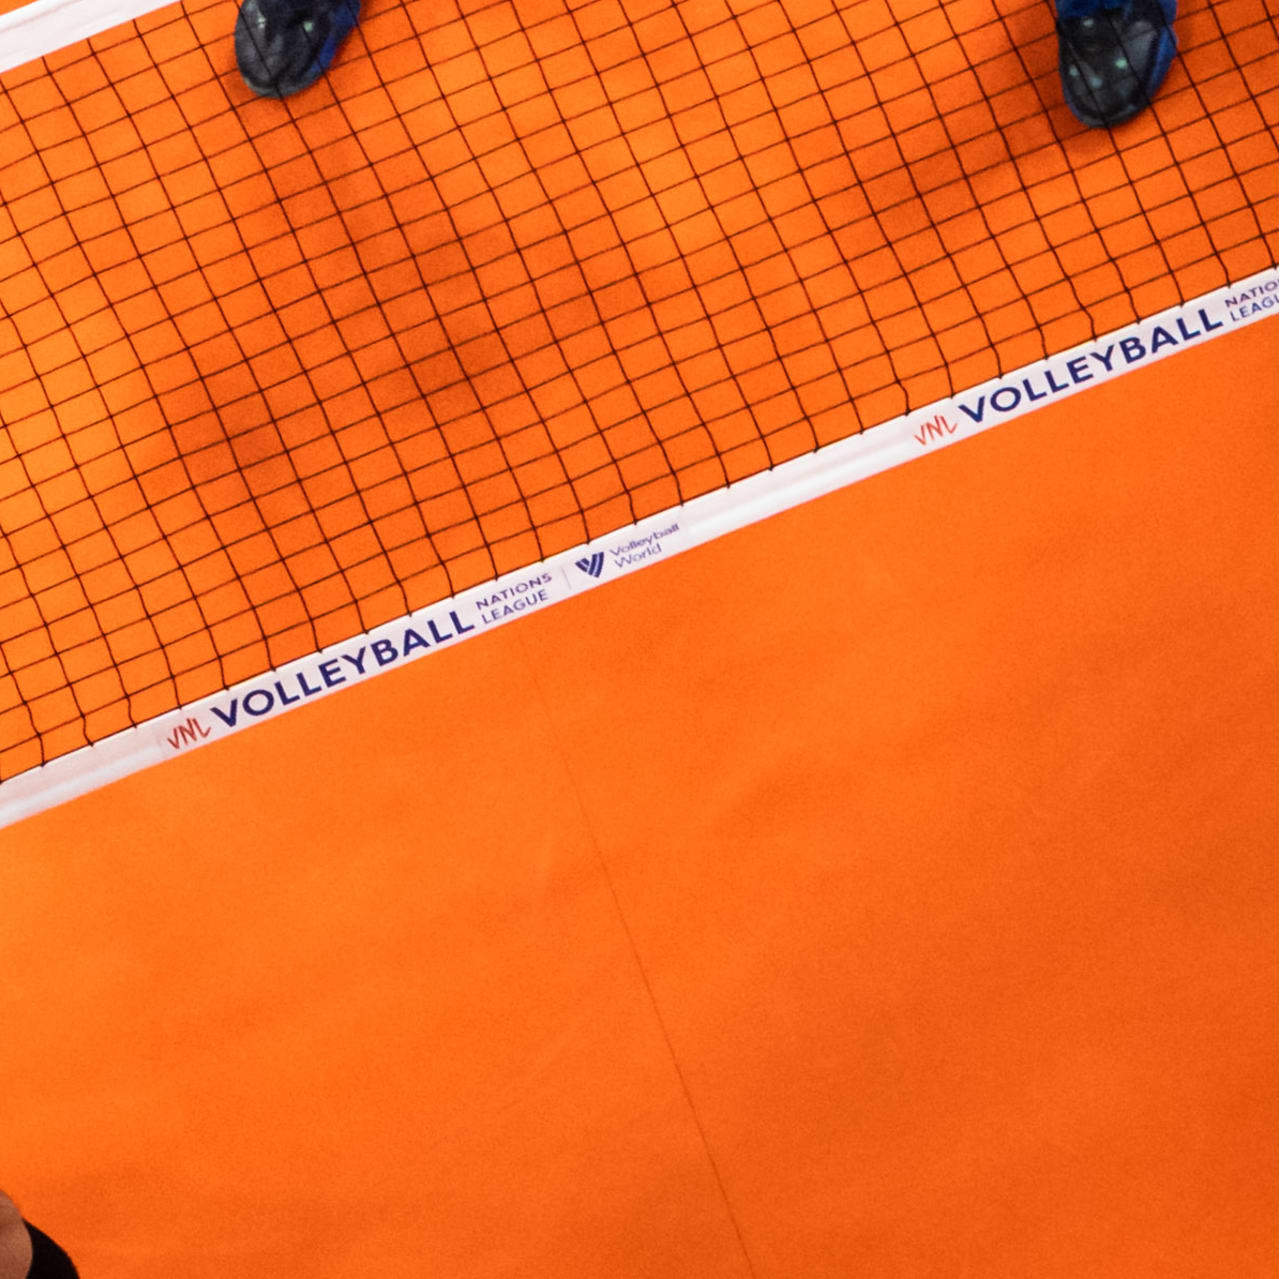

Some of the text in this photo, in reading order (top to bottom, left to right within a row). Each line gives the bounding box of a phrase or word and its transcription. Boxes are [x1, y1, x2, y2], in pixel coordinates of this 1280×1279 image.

[913, 278, 1279, 446] VNL VOLLEYBALL NATIO
[609, 522, 680, 557] Volleyball
[614, 542, 662, 569] World
[481, 588, 549, 625] LEAGUE
[167, 572, 553, 750] VNL VOLLEYBALL NATIONS
